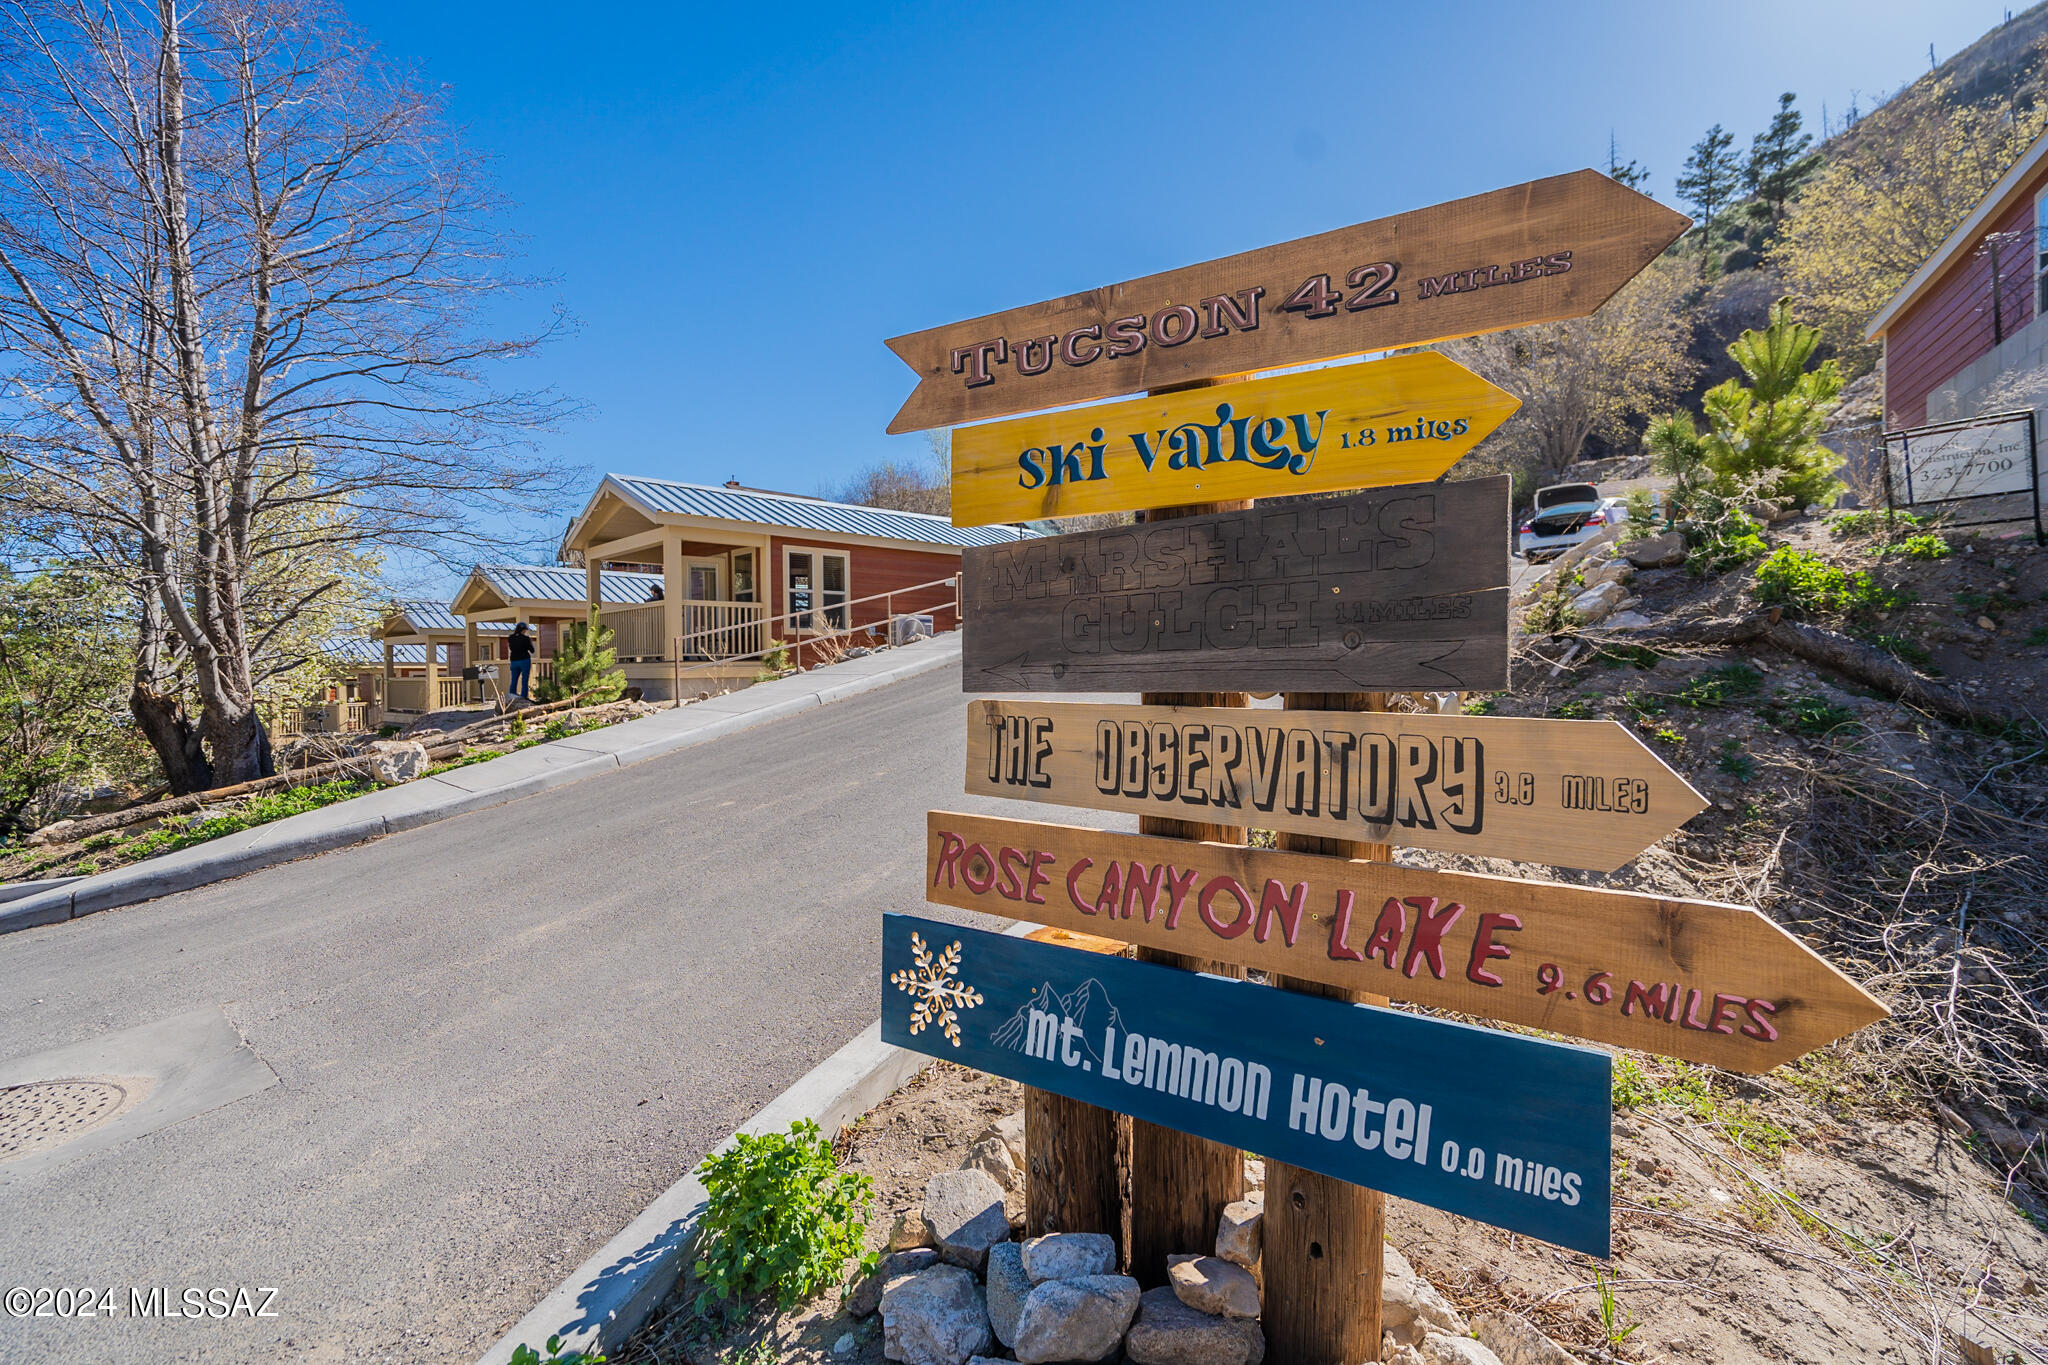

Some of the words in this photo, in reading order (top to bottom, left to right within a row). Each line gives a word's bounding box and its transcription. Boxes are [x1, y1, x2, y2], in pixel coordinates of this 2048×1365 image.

[950, 285, 1265, 390] TUCSON
[1283, 260, 1399, 320] 42
[1417, 250, 1573, 300] MILES
[1341, 428, 1376, 450] 1.8
[1386, 416, 1470, 444] miles
[1920, 458, 2013, 483] 323-7700
[1999, 442, 2023, 454] Inc.
[992, 494, 1436, 602] MARSHAL'S
[1062, 580, 1320, 654] GULCH
[1335, 600, 1365, 624] 1.1
[1368, 595, 1472, 623] MILES
[986, 715, 1053, 788] THE
[1095, 719, 1484, 835] OBSERVATORY
[1561, 774, 1649, 814] MILES
[934, 831, 1056, 904] ROSE
[1066, 857, 1309, 948] CANYON
[1327, 888, 1523, 987] LAKE
[1536, 962, 1614, 1007] 9.6
[1620, 979, 1779, 1043] MILES
[1101, 1026, 1272, 1121] Lemmon
[1441, 1140, 1485, 1180] 0.0
[1494, 1153, 1582, 1207] miles
